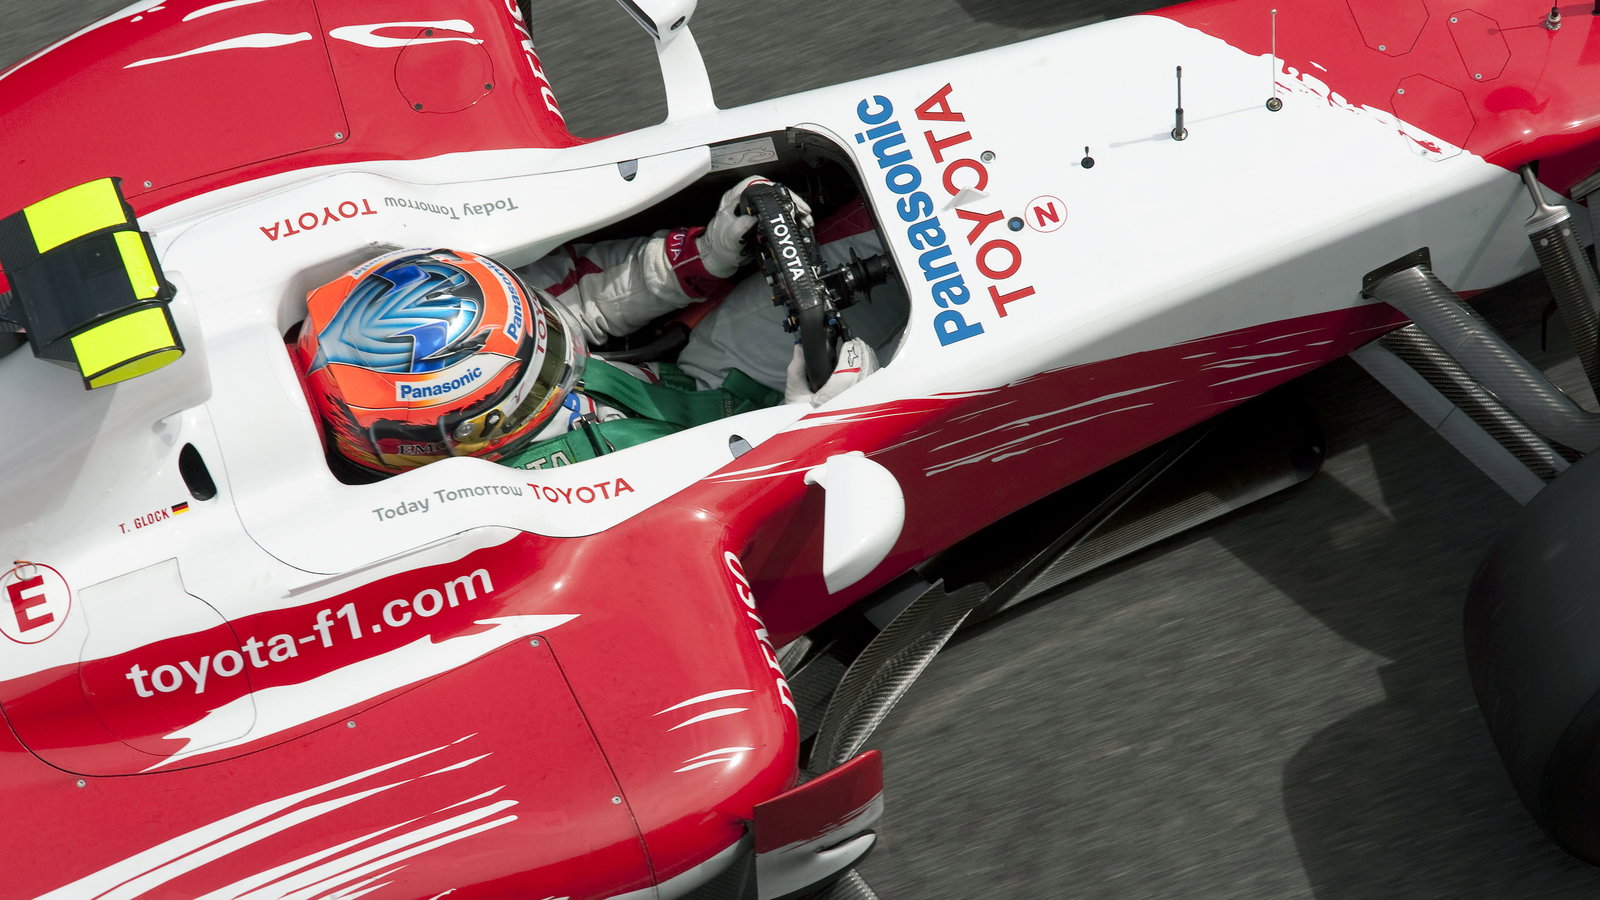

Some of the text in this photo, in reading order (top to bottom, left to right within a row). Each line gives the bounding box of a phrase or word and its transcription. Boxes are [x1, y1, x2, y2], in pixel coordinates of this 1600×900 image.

[259, 196, 519, 242] Today Tomorrow TOYOTA
[854, 94, 985, 347] Panasonic
[914, 82, 1036, 318] TOYOTA
[770, 213, 805, 282] TOYOTA
[483, 257, 524, 341] Panasonic
[400, 366, 482, 399] Panasonic
[118, 508, 170, 534] T. GLOCK
[372, 477, 635, 523] Today Tomorrow TOYOTA
[6, 574, 55, 633] E
[125, 567, 495, 700] toyota-f1.com
